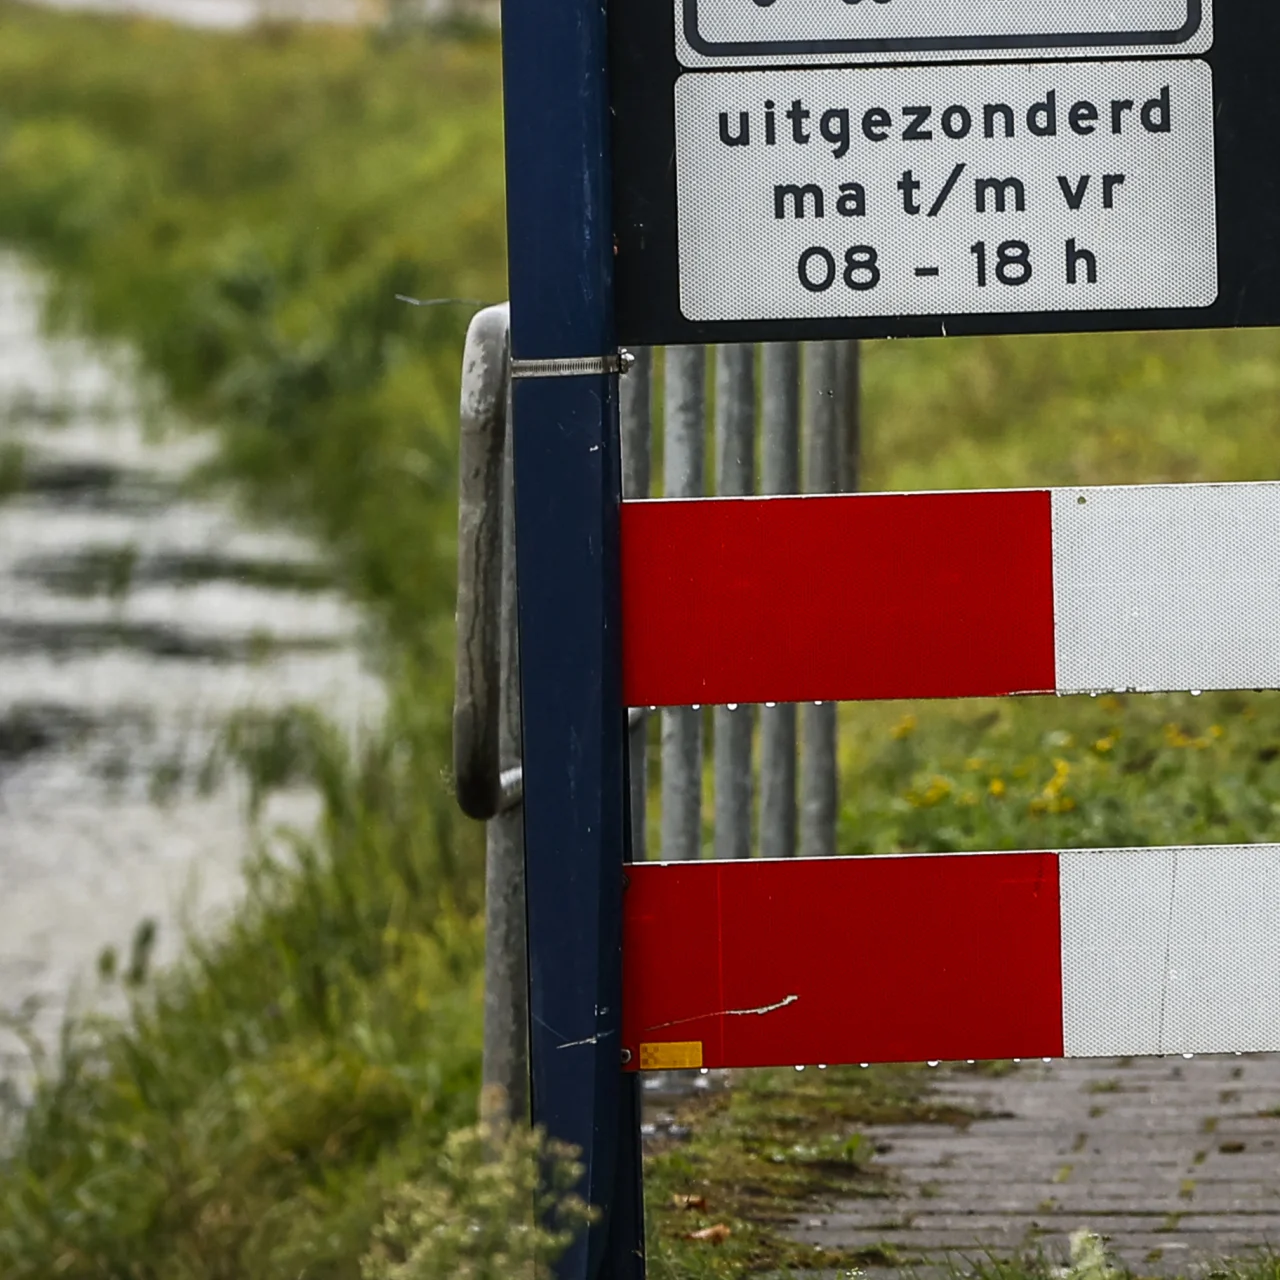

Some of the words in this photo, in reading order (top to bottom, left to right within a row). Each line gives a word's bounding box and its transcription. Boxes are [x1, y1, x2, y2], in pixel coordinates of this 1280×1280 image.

[718, 85, 1172, 159] uitgezonderd
[773, 181, 867, 220] ma
[897, 163, 1025, 217] t/m
[1057, 172, 1126, 210] vr
[797, 244, 881, 292] 08
[970, 239, 1032, 287] 18
[1065, 237, 1098, 284] h
